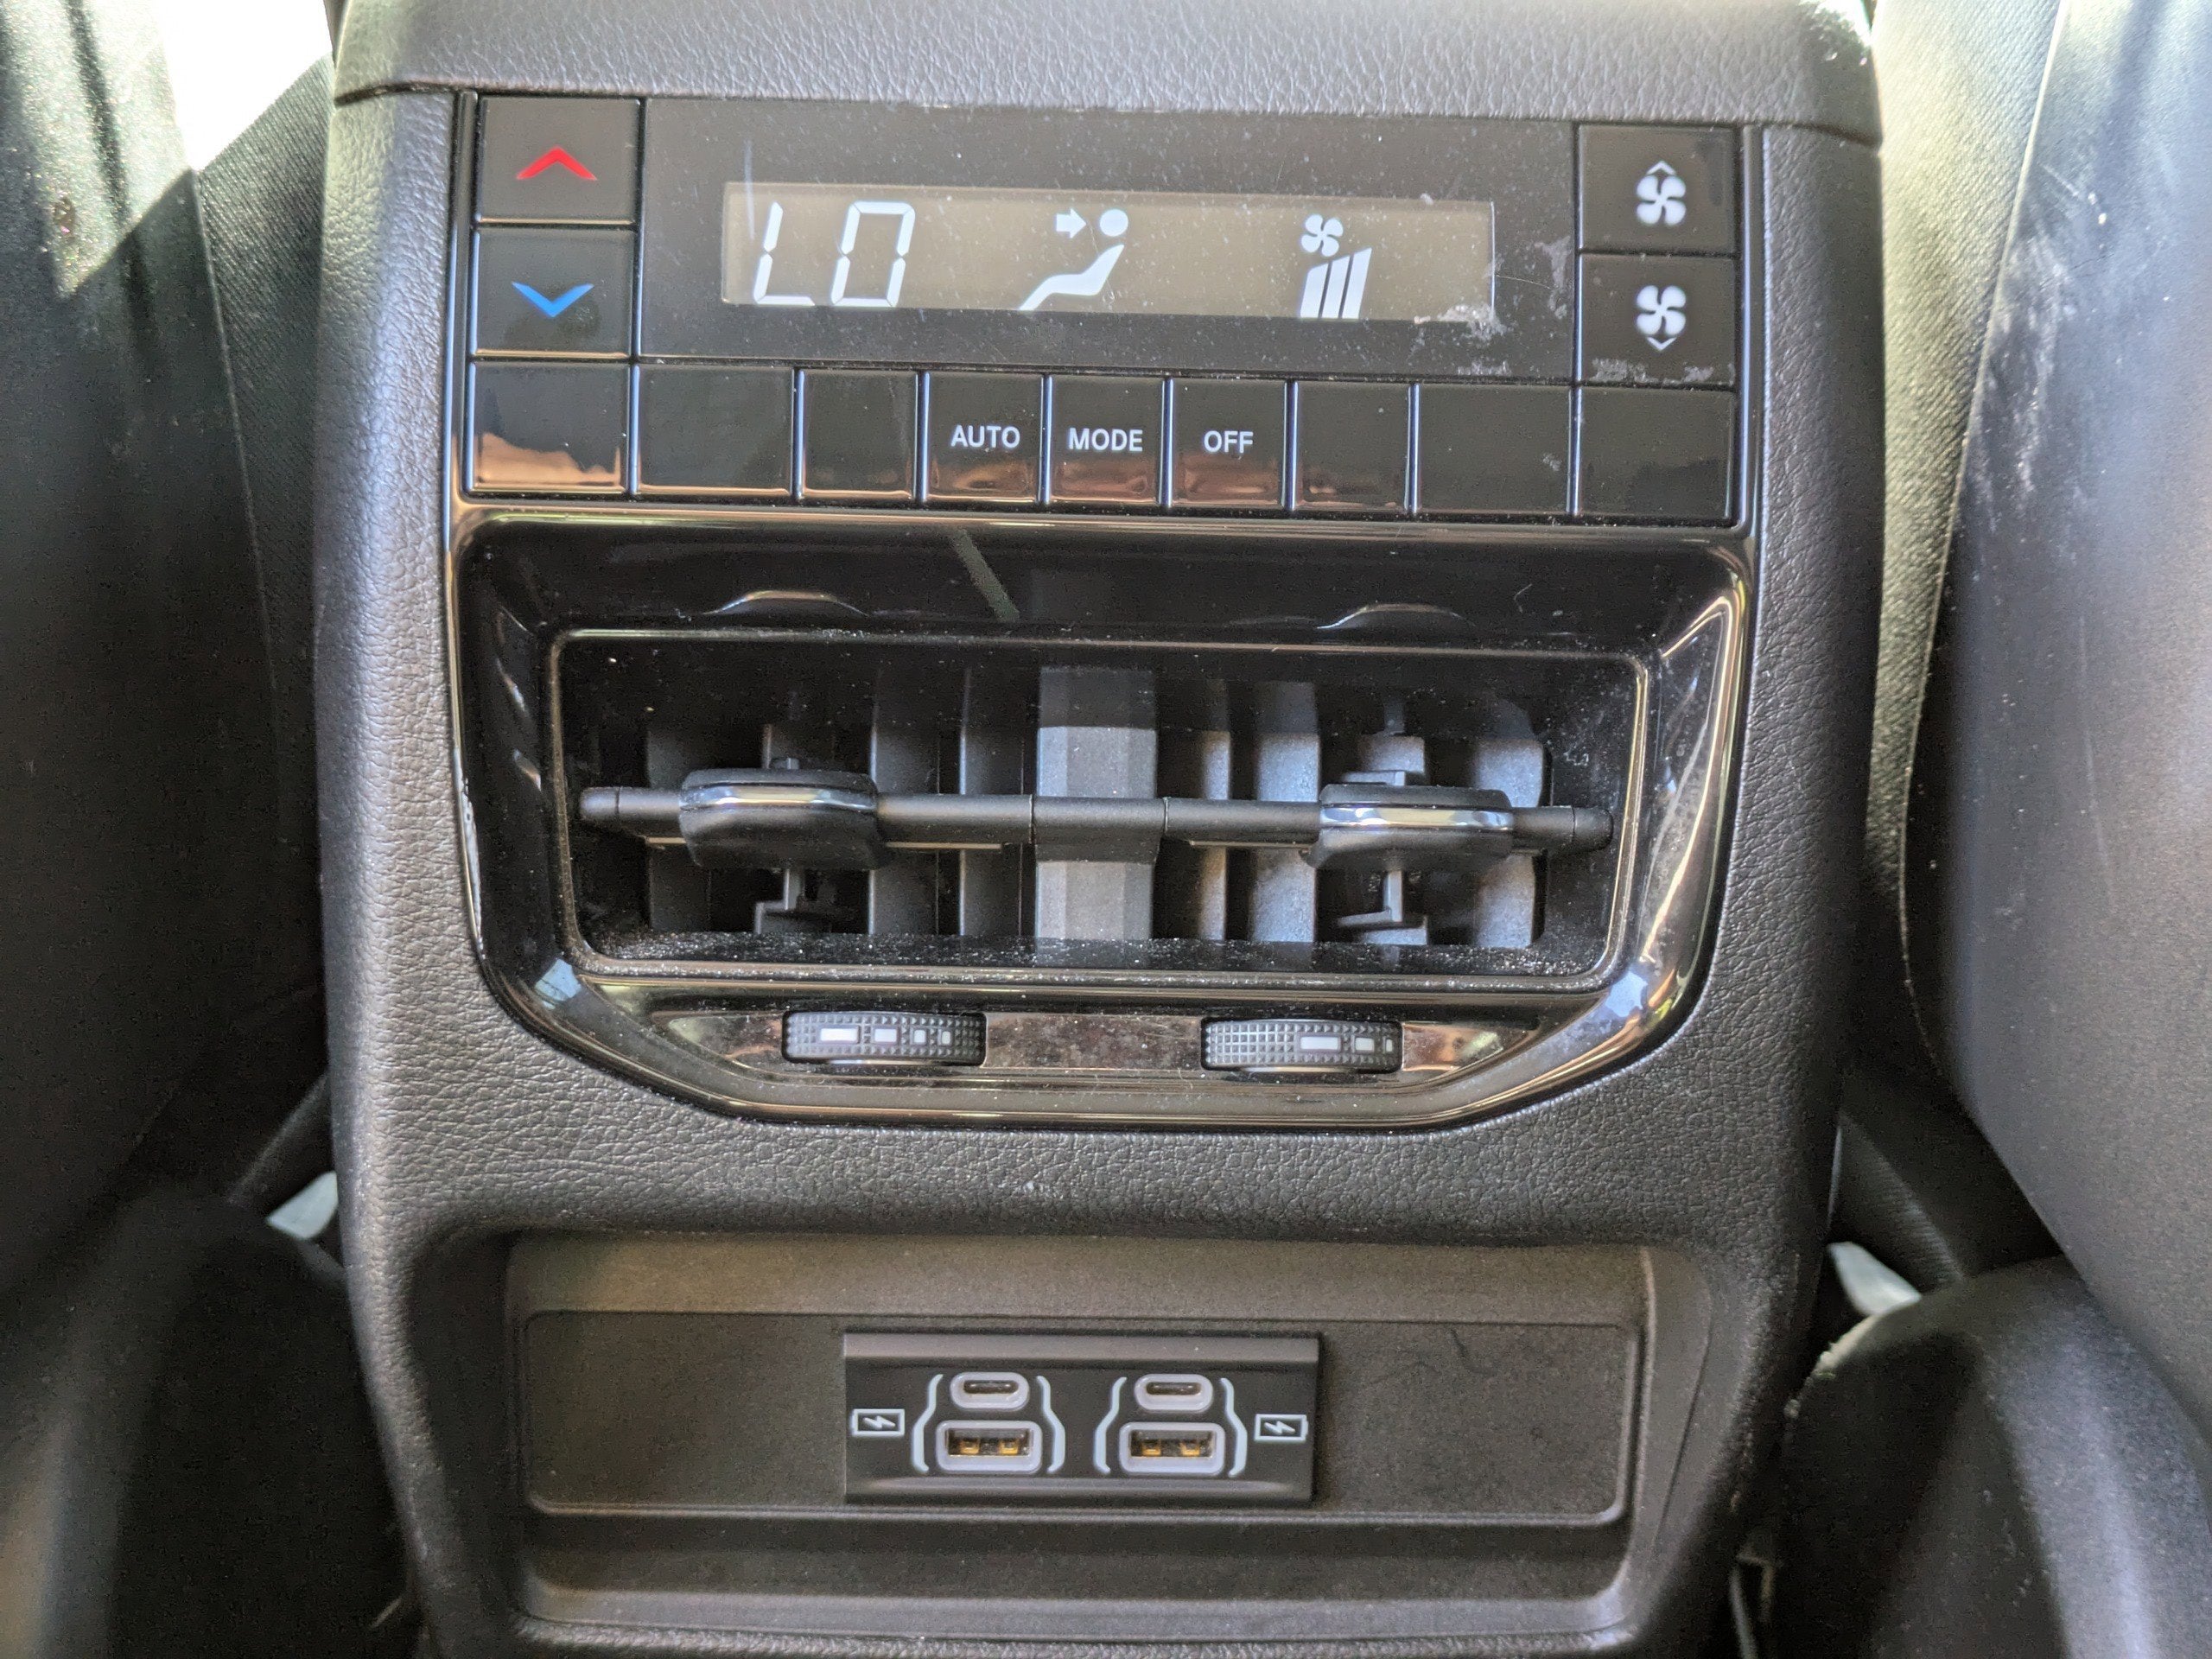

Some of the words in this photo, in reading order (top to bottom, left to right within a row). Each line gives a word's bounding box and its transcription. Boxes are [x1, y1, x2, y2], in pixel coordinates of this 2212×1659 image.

[950, 424, 1020, 449] AUTO
[1067, 427, 1144, 453] MODE
[1203, 429, 1255, 454] OFF
